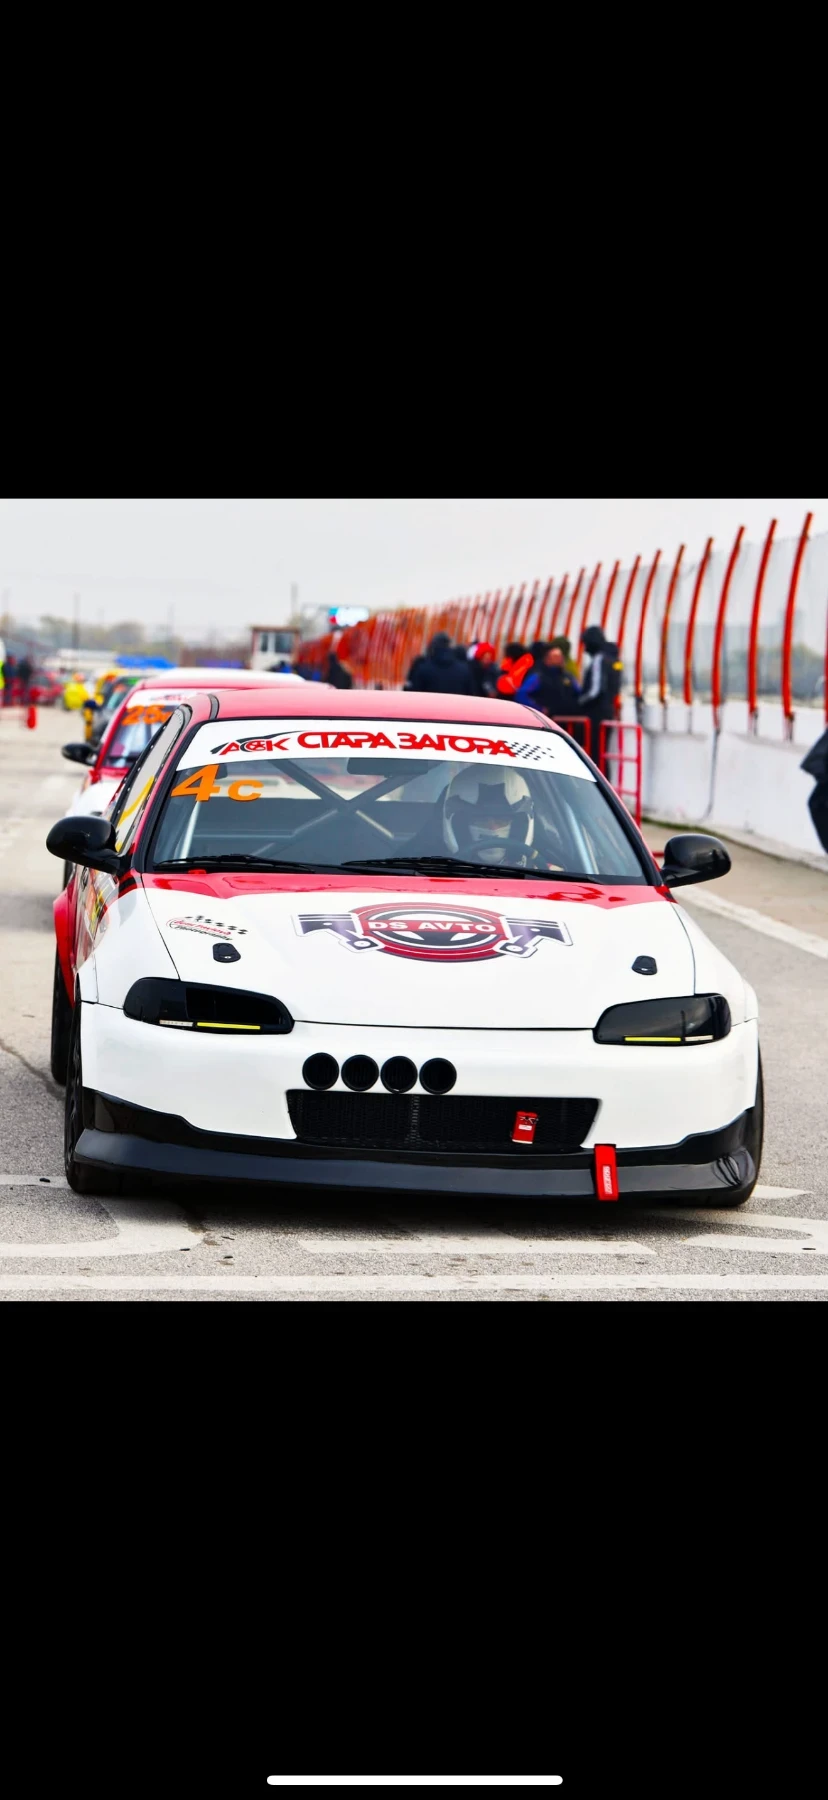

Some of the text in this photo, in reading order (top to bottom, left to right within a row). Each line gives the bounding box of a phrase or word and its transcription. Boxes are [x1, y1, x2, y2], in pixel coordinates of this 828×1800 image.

[297, 731, 396, 749] СТАРА
[397, 732, 517, 757] ЗАГОРА
[368, 921, 497, 933] DS AVTO
